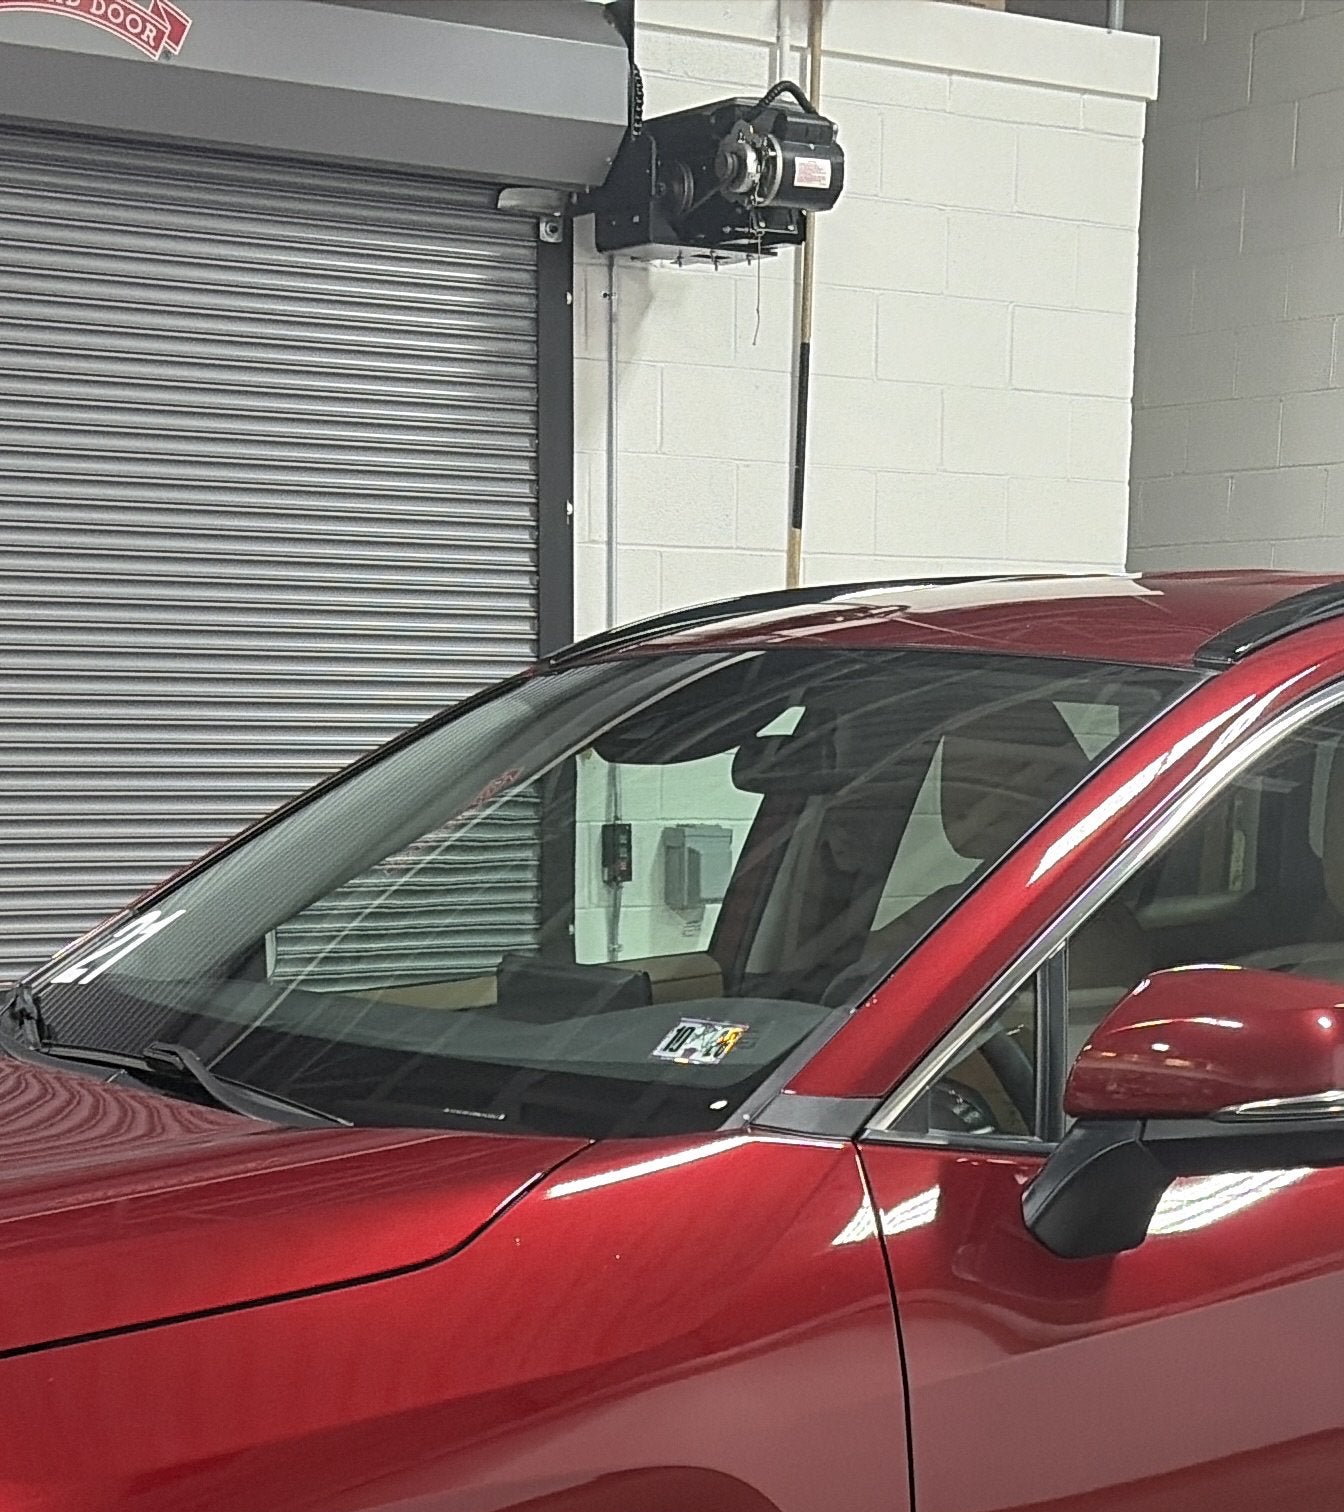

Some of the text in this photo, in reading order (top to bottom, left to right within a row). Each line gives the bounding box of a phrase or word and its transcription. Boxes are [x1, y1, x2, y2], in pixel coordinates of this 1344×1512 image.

[90, 0, 157, 47] DOOR
[50, 909, 187, 985] 21
[662, 1026, 696, 1053] 10
